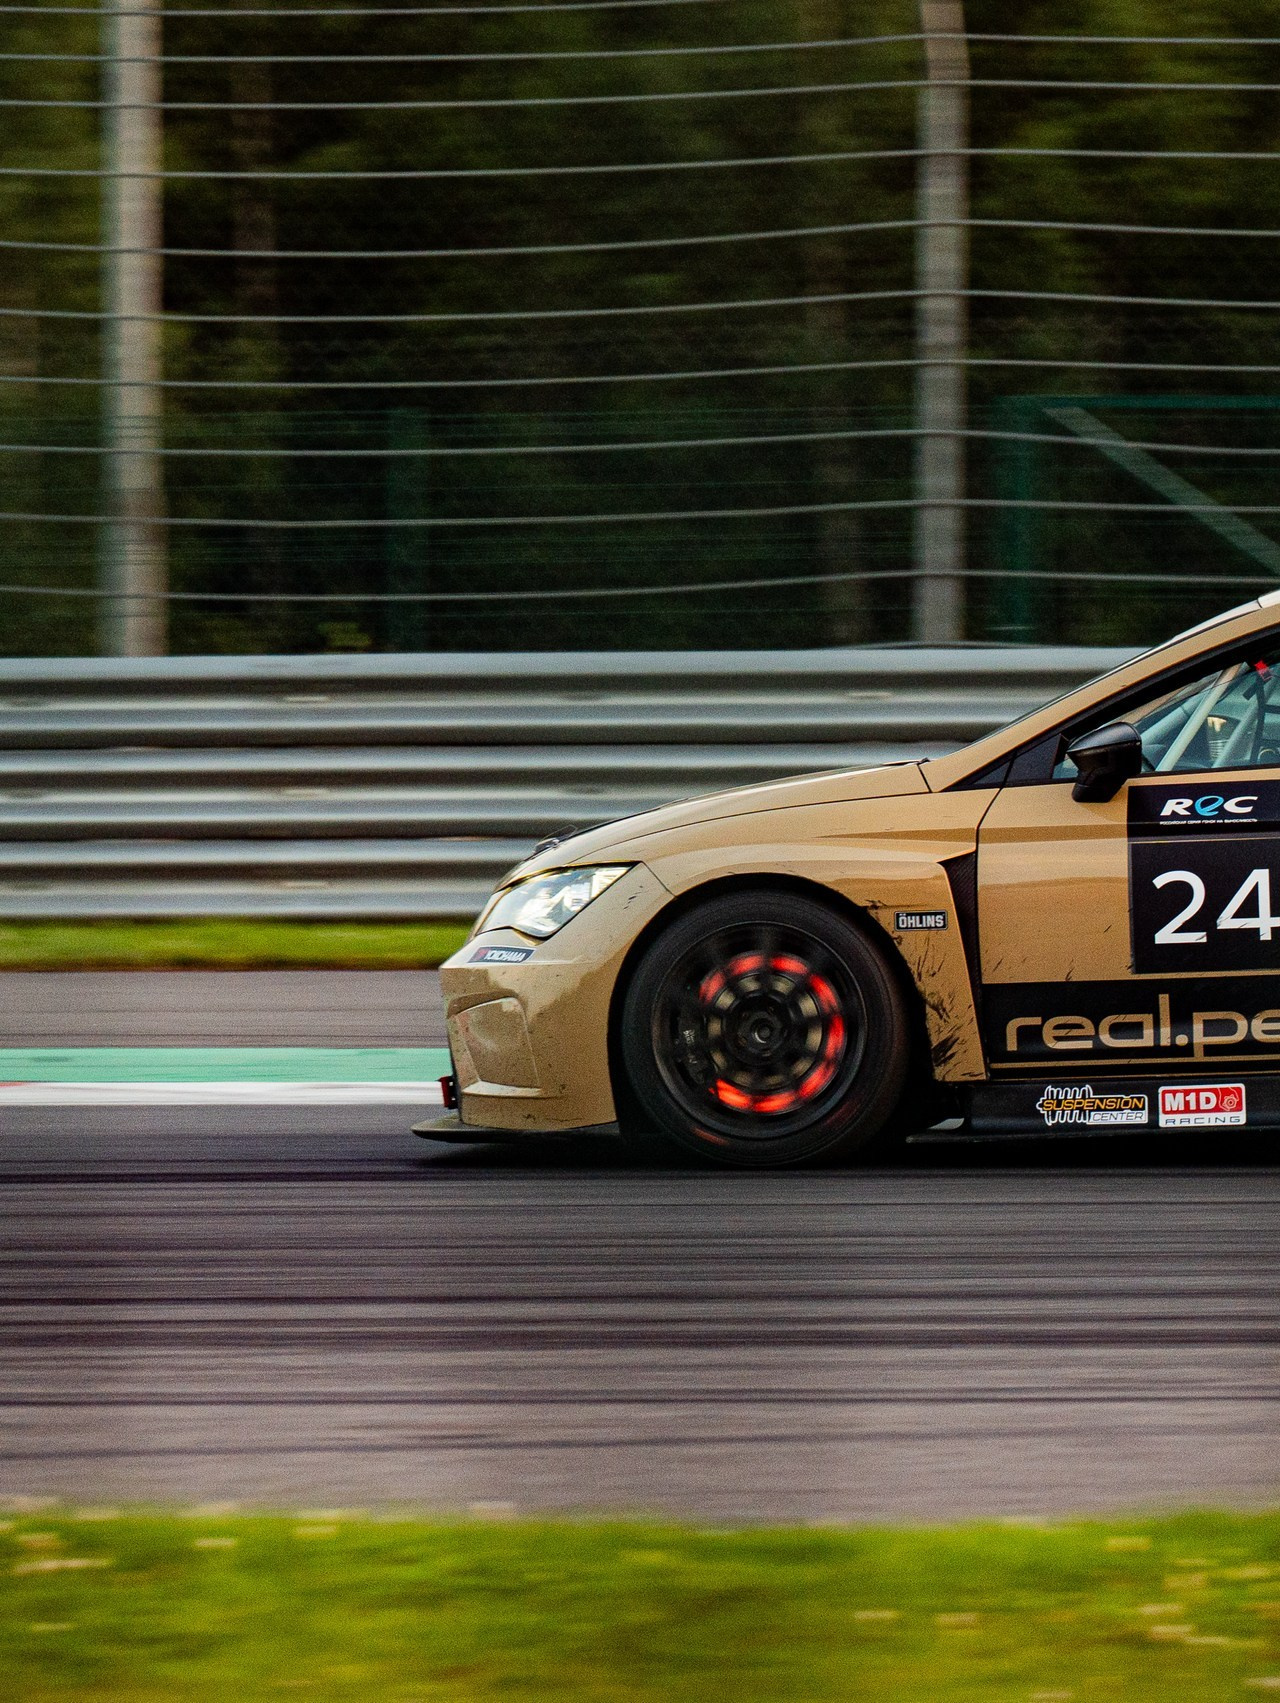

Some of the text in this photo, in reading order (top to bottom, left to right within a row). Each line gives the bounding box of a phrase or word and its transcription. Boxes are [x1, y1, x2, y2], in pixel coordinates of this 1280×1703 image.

[1152, 868, 1280, 945] 24
[898, 913, 944, 928] ÖHLINS
[1042, 1097, 1145, 1111] SUSPENSION
[1164, 1091, 1216, 1111] M1D
[1092, 1111, 1144, 1122] CENTER
[1165, 1115, 1241, 1126] RACING
